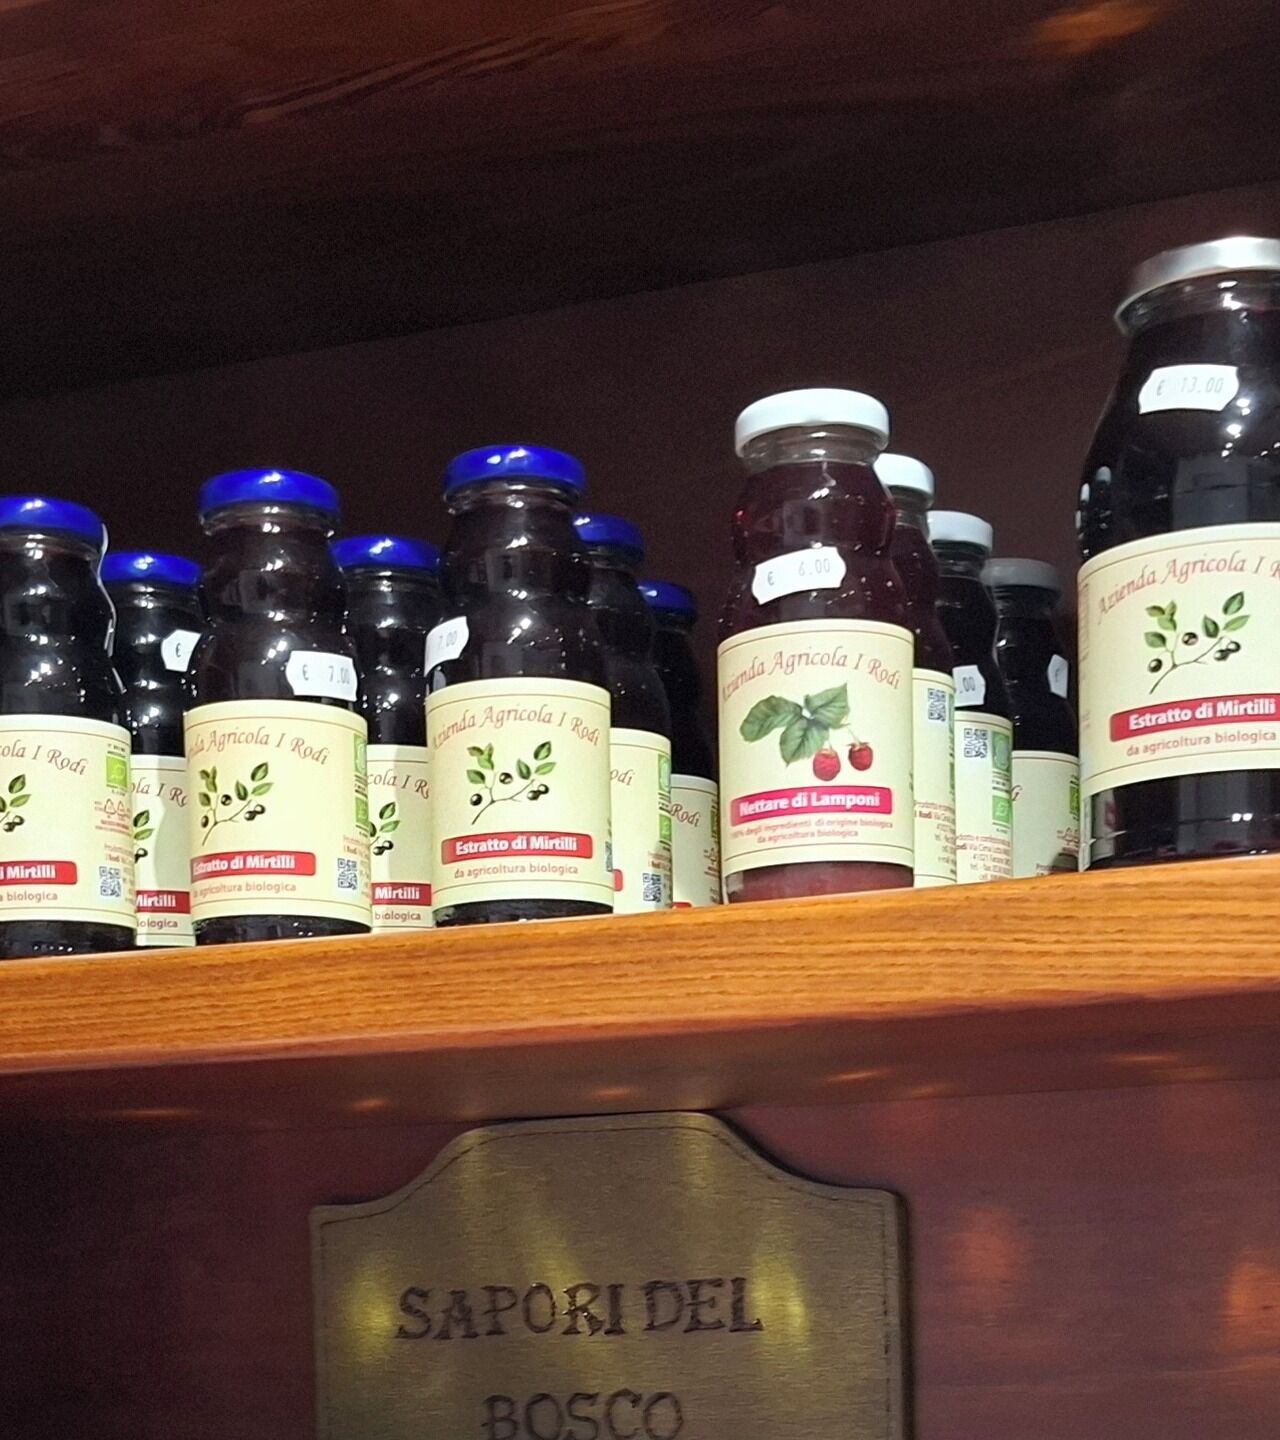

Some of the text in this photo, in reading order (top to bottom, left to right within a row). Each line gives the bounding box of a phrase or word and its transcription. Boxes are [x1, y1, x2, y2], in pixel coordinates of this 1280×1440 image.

[1180, 377, 1224, 393] 13.00
[767, 559, 831, 585] € 6.00
[1097, 564, 1158, 615] Azienda
[1161, 550, 1247, 586] Agricola
[302, 665, 351, 682] € 7.00
[767, 646, 902, 690] Agricola Rodi
[480, 704, 601, 747] Agricola Rodi
[1128, 697, 1276, 731] Estratto di Mirtilli
[206, 727, 330, 765] Agricola Rodi
[1126, 728, 1277, 756] da agricoltura biologica
[47, 748, 89, 776] Rodi
[671, 802, 702, 828] Rodi
[739, 791, 881, 817] Nettare di Lamponi
[455, 834, 578, 857] Estratto di Mirtilli
[6, 865, 56, 879] Mirtilli
[230, 852, 296, 869] di Mirtilli
[466, 863, 579, 879] agricoltura biologica
[6, 892, 58, 904] biologica
[245, 880, 297, 893] biologica
[375, 886, 420, 900] Mirtilli
[375, 910, 421, 922] biologica
[393, 1276, 765, 1342] SAPORI DEL
